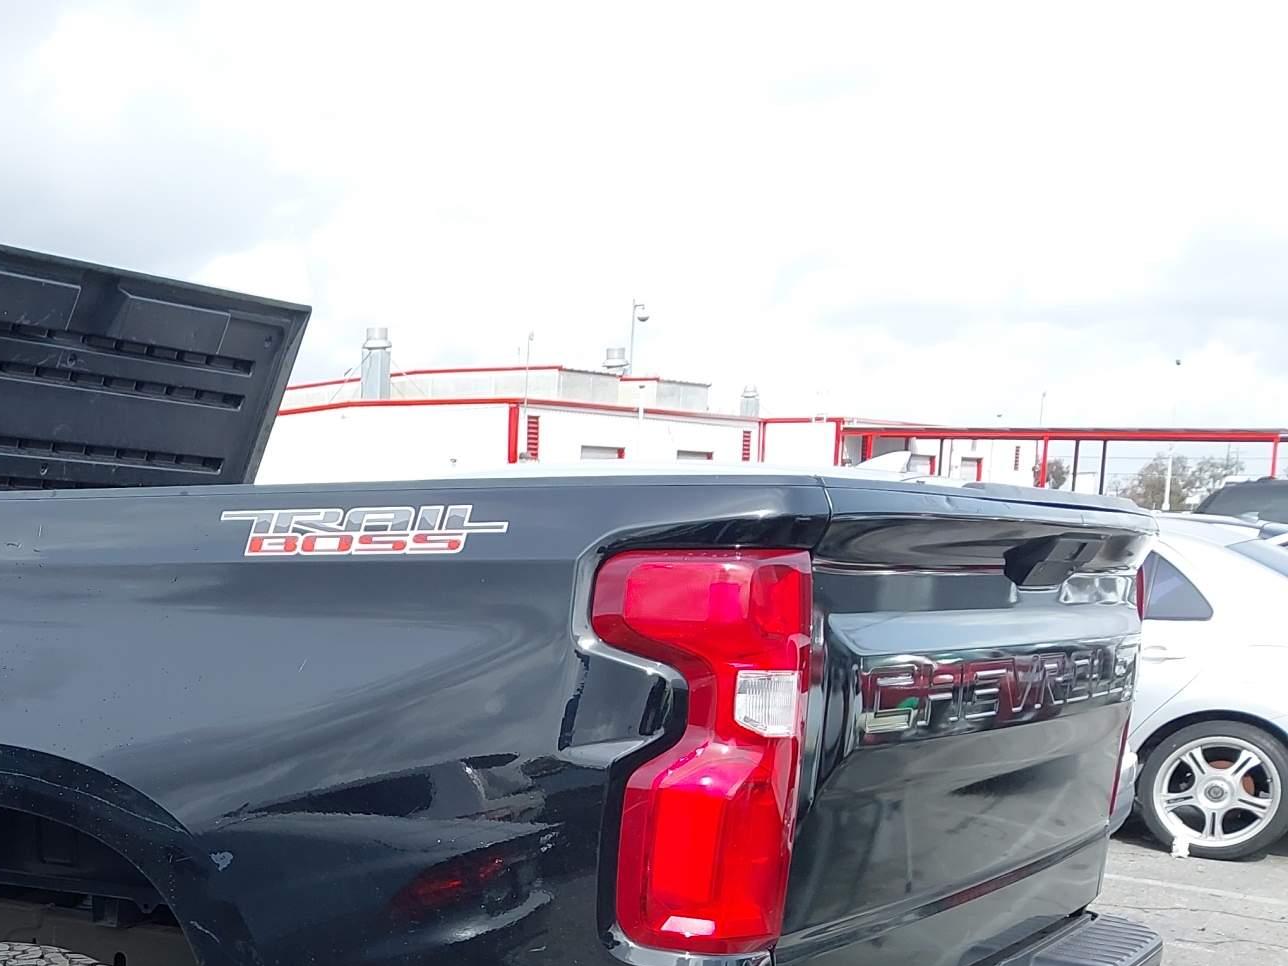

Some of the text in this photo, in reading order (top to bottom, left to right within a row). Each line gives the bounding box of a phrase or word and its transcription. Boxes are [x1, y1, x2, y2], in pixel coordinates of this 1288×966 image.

[220, 504, 509, 534] TRAIL
[244, 532, 467, 556] BOSS
[862, 638, 1139, 734] CHEVROLET
